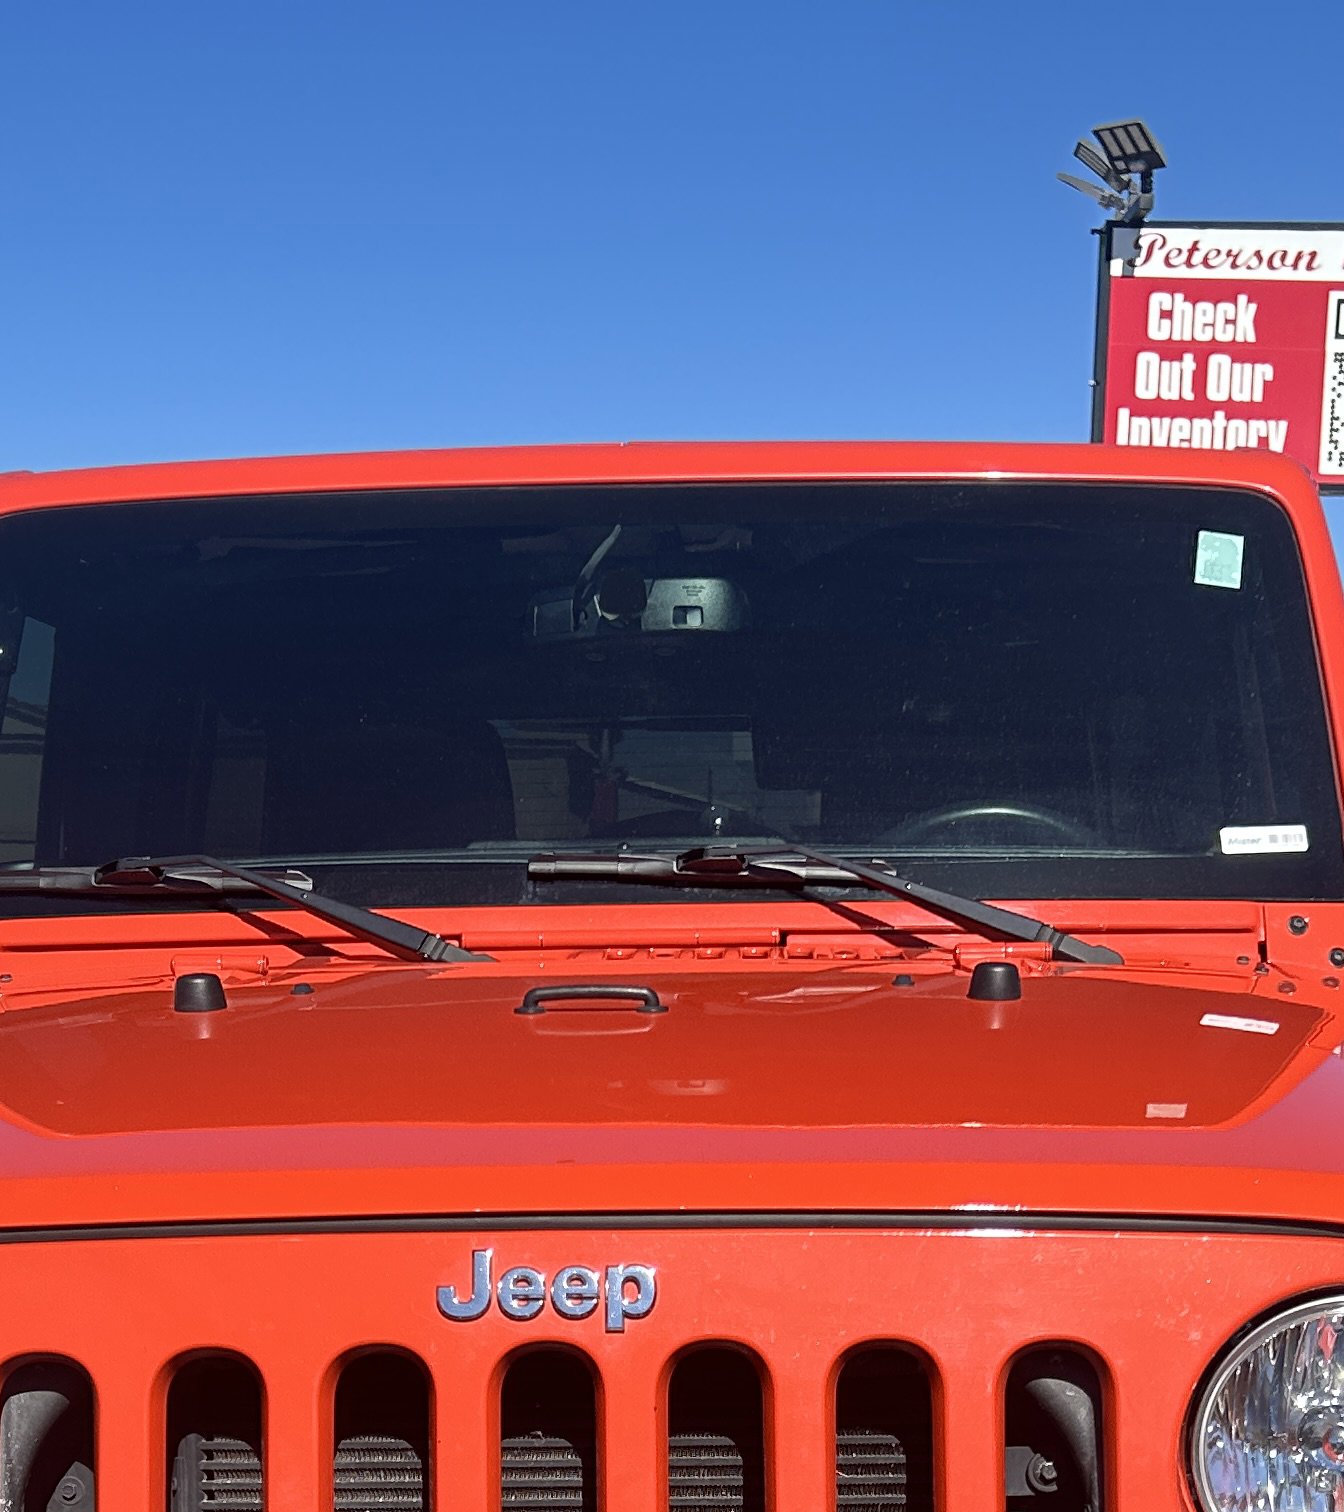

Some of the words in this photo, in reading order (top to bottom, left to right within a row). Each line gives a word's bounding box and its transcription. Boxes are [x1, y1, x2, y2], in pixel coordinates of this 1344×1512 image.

[1127, 232, 1320, 272] Peterson
[1146, 291, 1258, 343] Check
[1134, 351, 1197, 401] Out
[1205, 353, 1275, 403] Our
[1115, 407, 1288, 453] Inventory
[436, 1248, 657, 1334] Jeep
